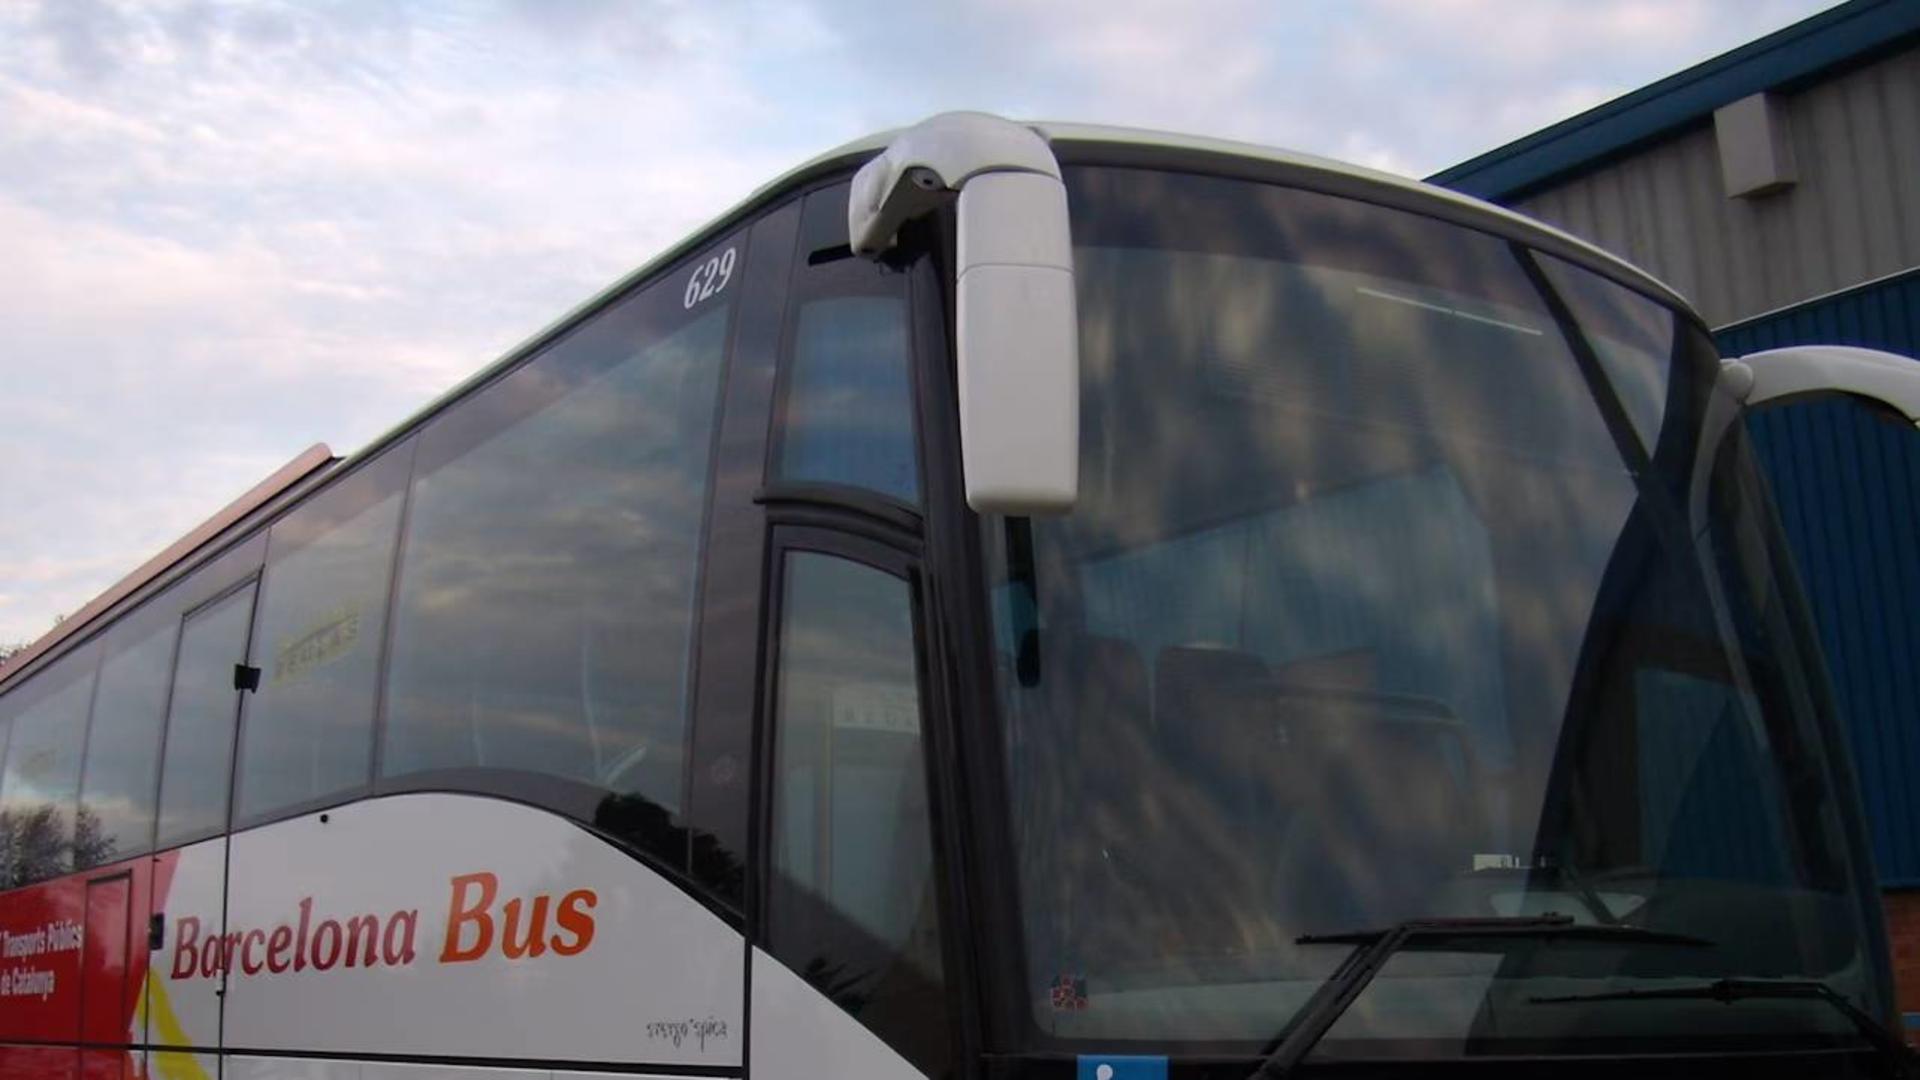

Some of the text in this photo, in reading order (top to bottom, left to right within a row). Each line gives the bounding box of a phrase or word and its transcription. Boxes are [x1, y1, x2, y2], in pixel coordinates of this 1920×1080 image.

[683, 247, 737, 310] 629
[3, 927, 46, 963] Transports
[171, 872, 598, 980] Barcelona Bus
[0, 965, 55, 1002] de Catalunya
